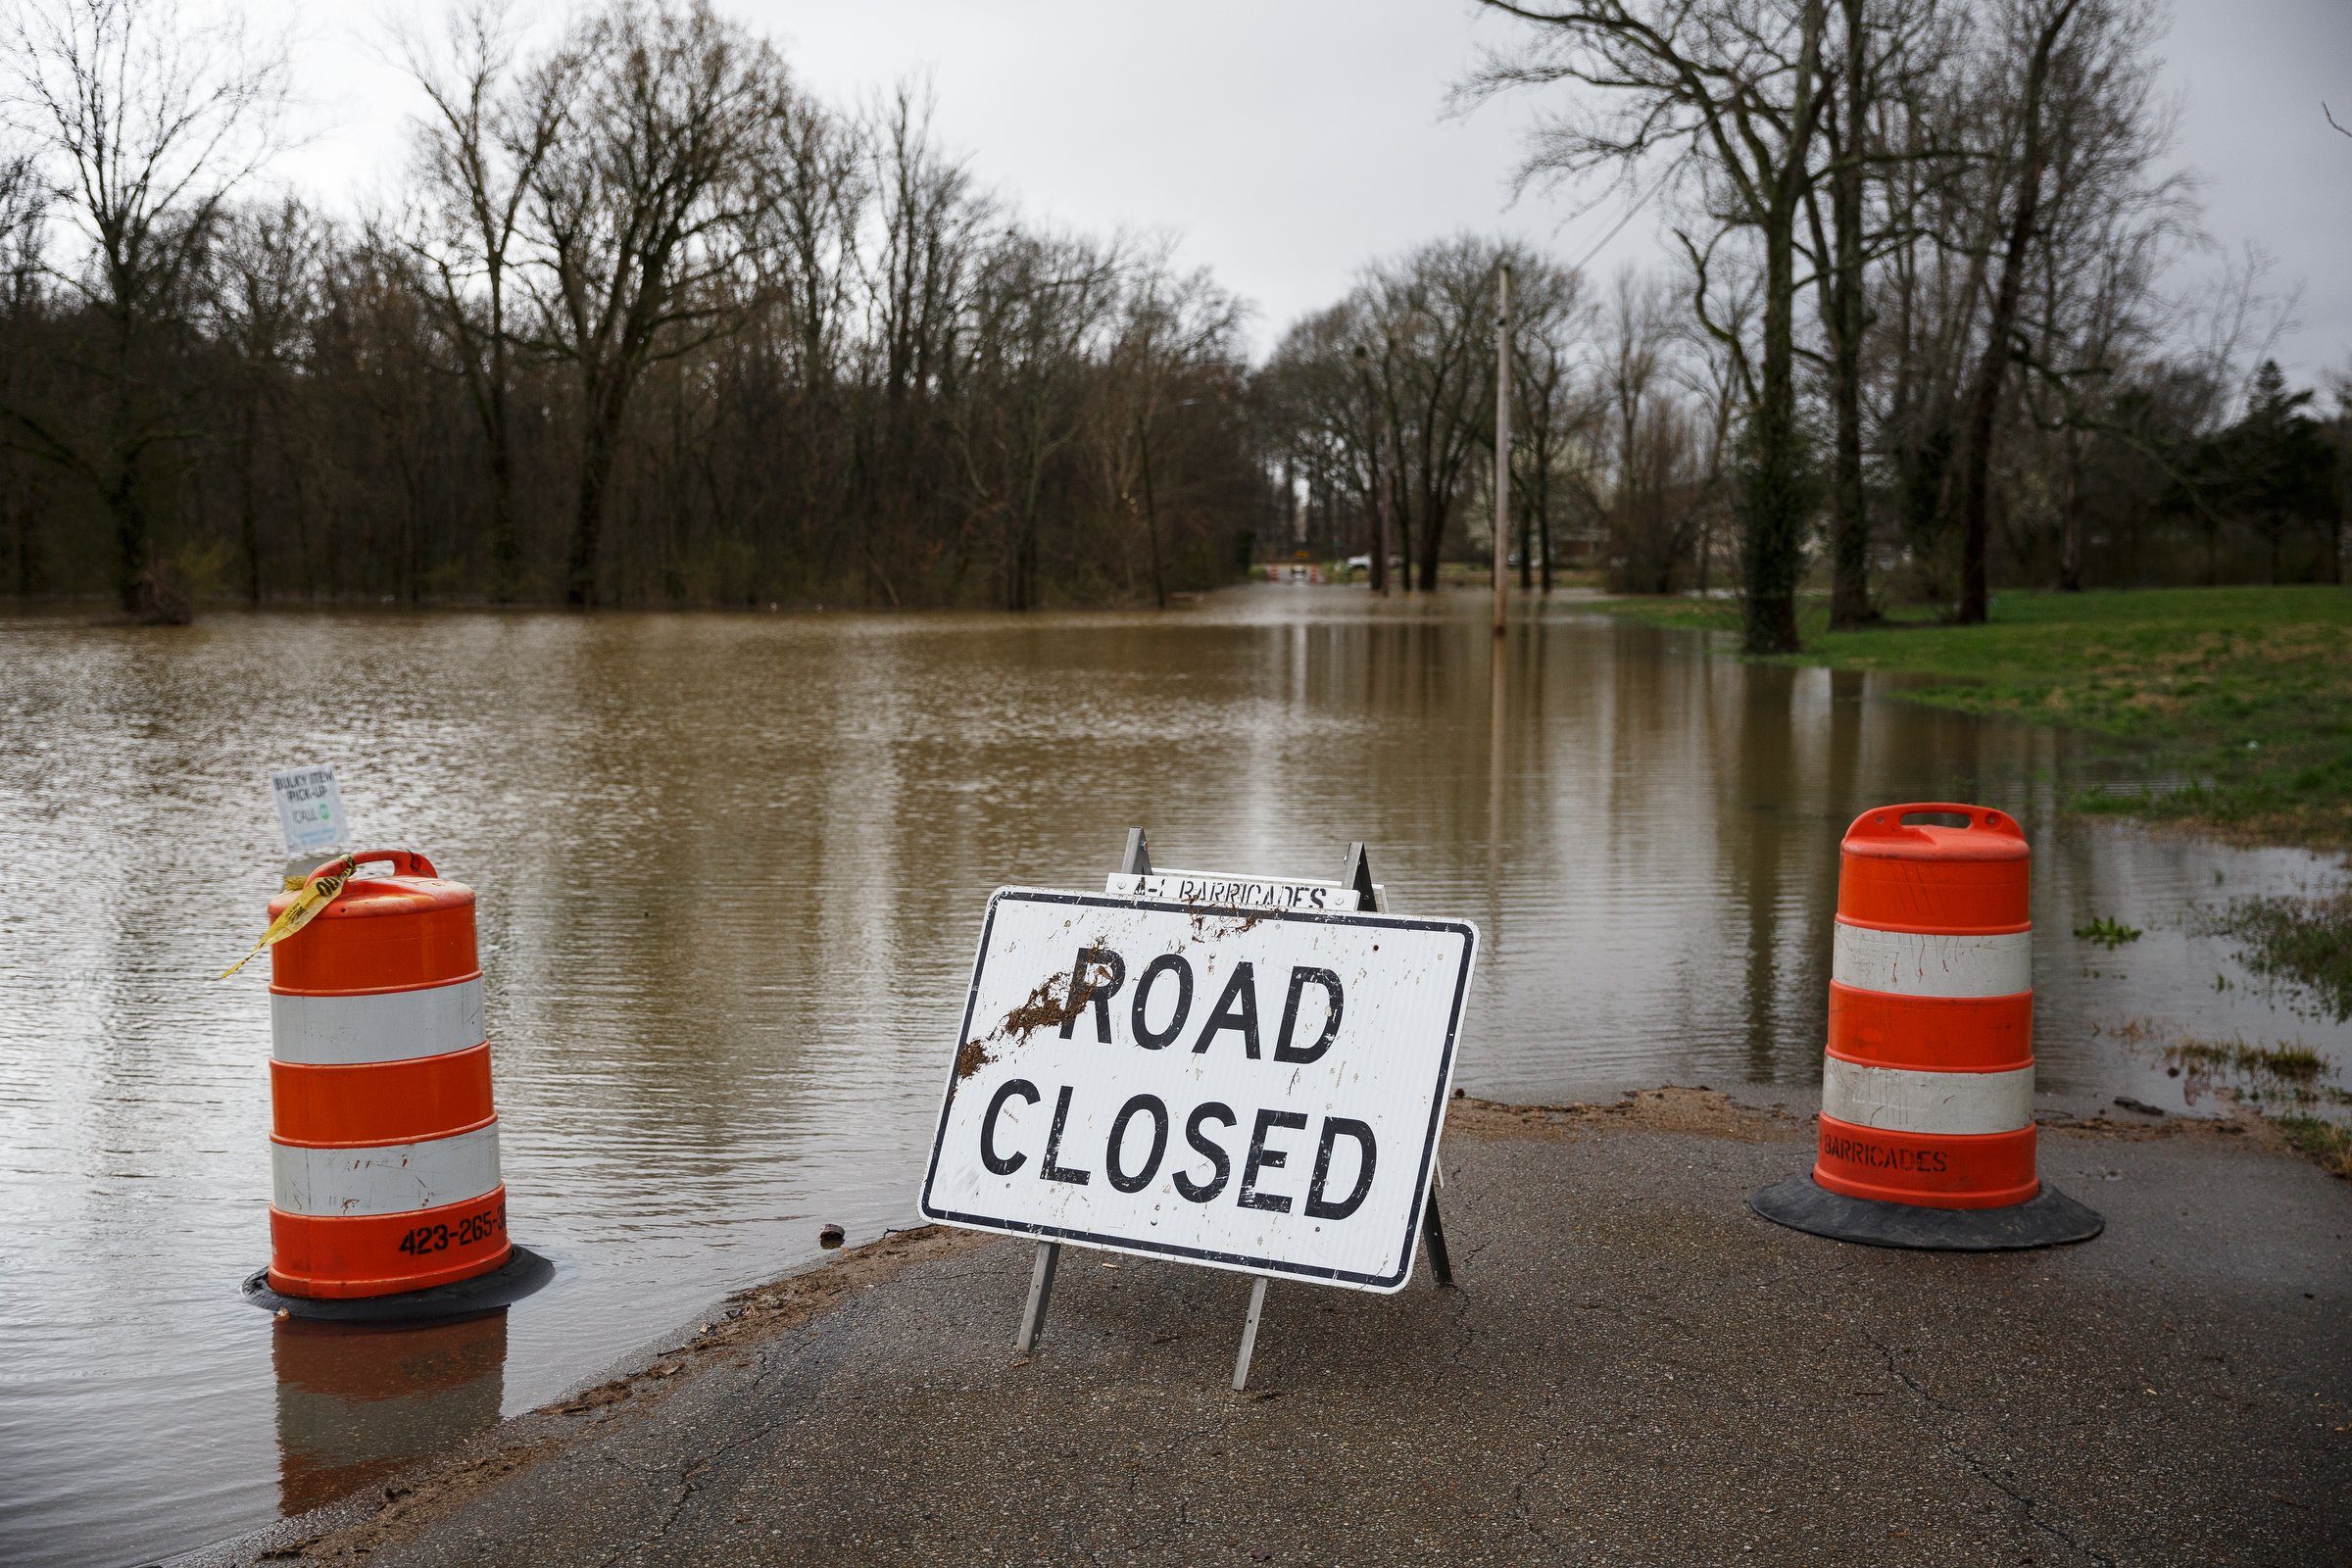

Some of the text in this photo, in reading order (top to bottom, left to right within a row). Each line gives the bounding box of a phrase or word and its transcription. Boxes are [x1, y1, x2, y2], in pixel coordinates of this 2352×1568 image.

[287, 786, 328, 802] PICK-UP
[1179, 880, 1328, 908] BARRICADES
[1058, 947, 1345, 1064] ROAD
[979, 1078, 1377, 1221] CLOSED
[1824, 1134, 1947, 1173] BARRICADES
